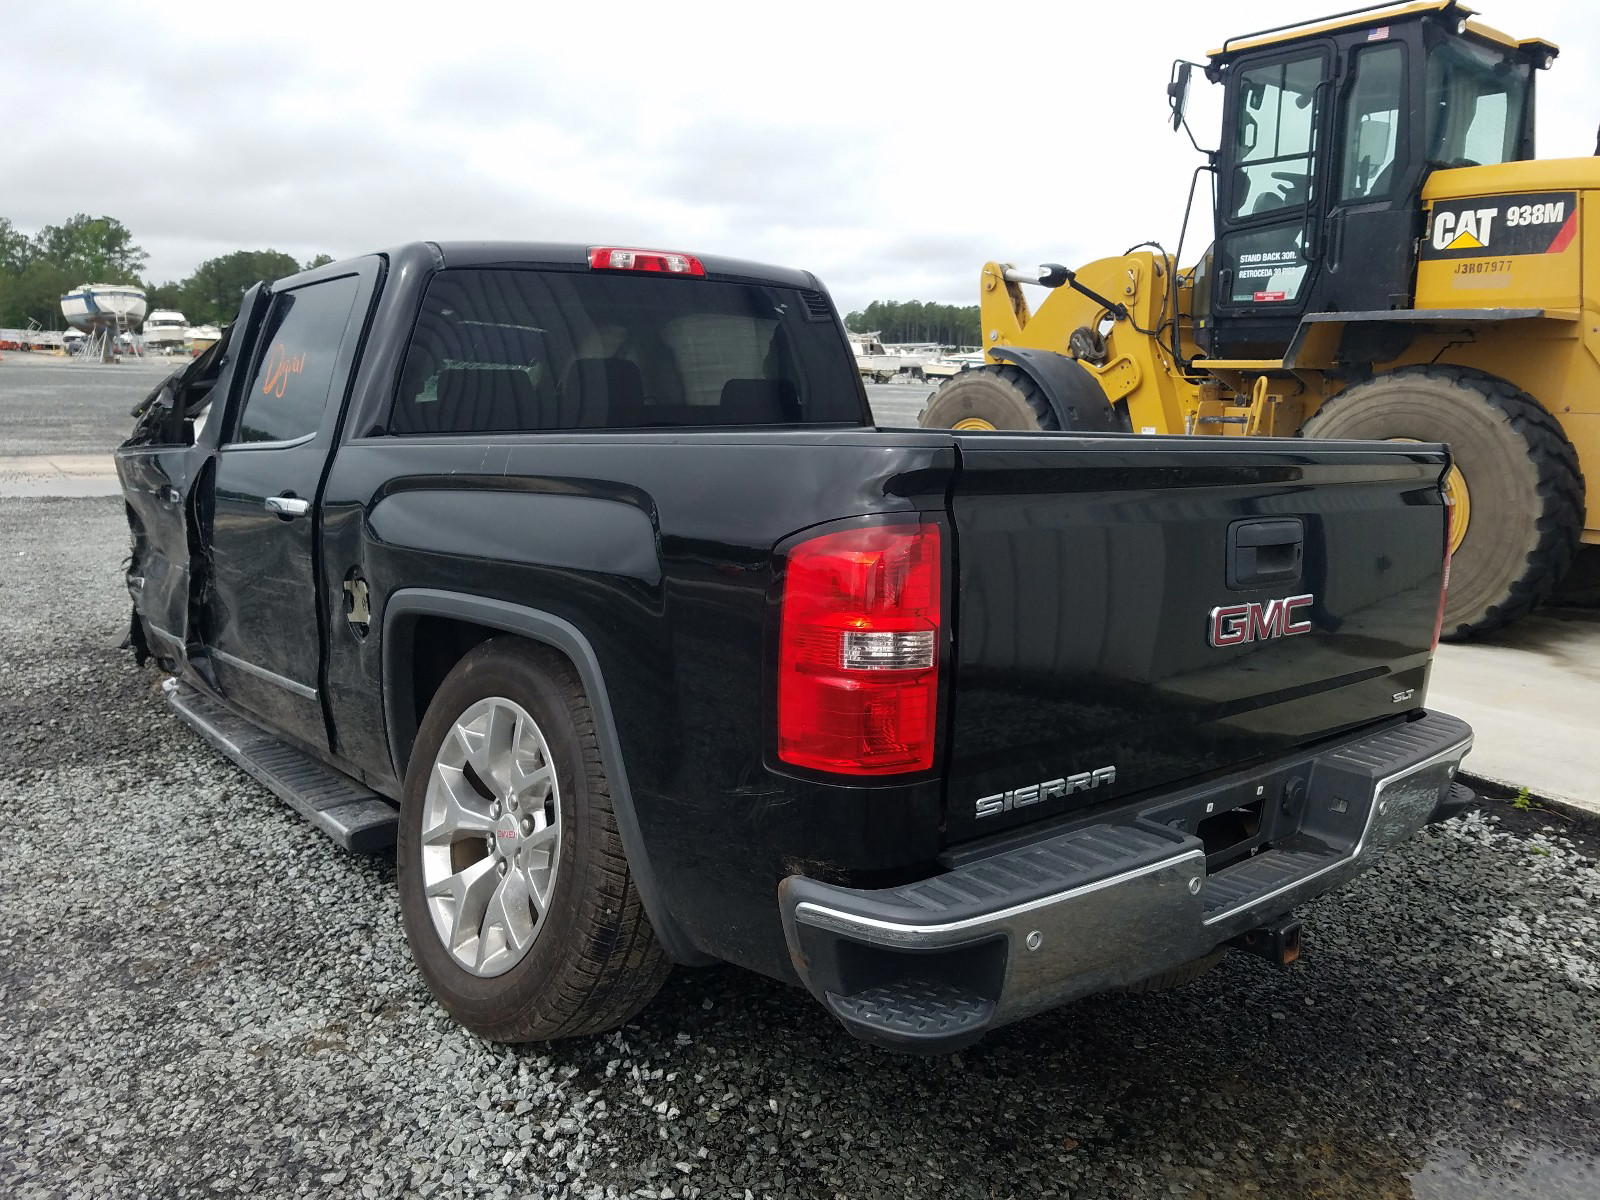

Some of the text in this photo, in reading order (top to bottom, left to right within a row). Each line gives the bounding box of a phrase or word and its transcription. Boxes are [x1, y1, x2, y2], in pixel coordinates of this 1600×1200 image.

[1433, 201, 1565, 250] CAT 938M
[1239, 268, 1272, 278] RETROCEDA
[1240, 253, 1261, 263] STAND
[1262, 251, 1281, 261] BACK
[1209, 593, 1314, 647] GMC
[1392, 688, 1415, 703] SLT
[975, 765, 1116, 819] SIERRA
